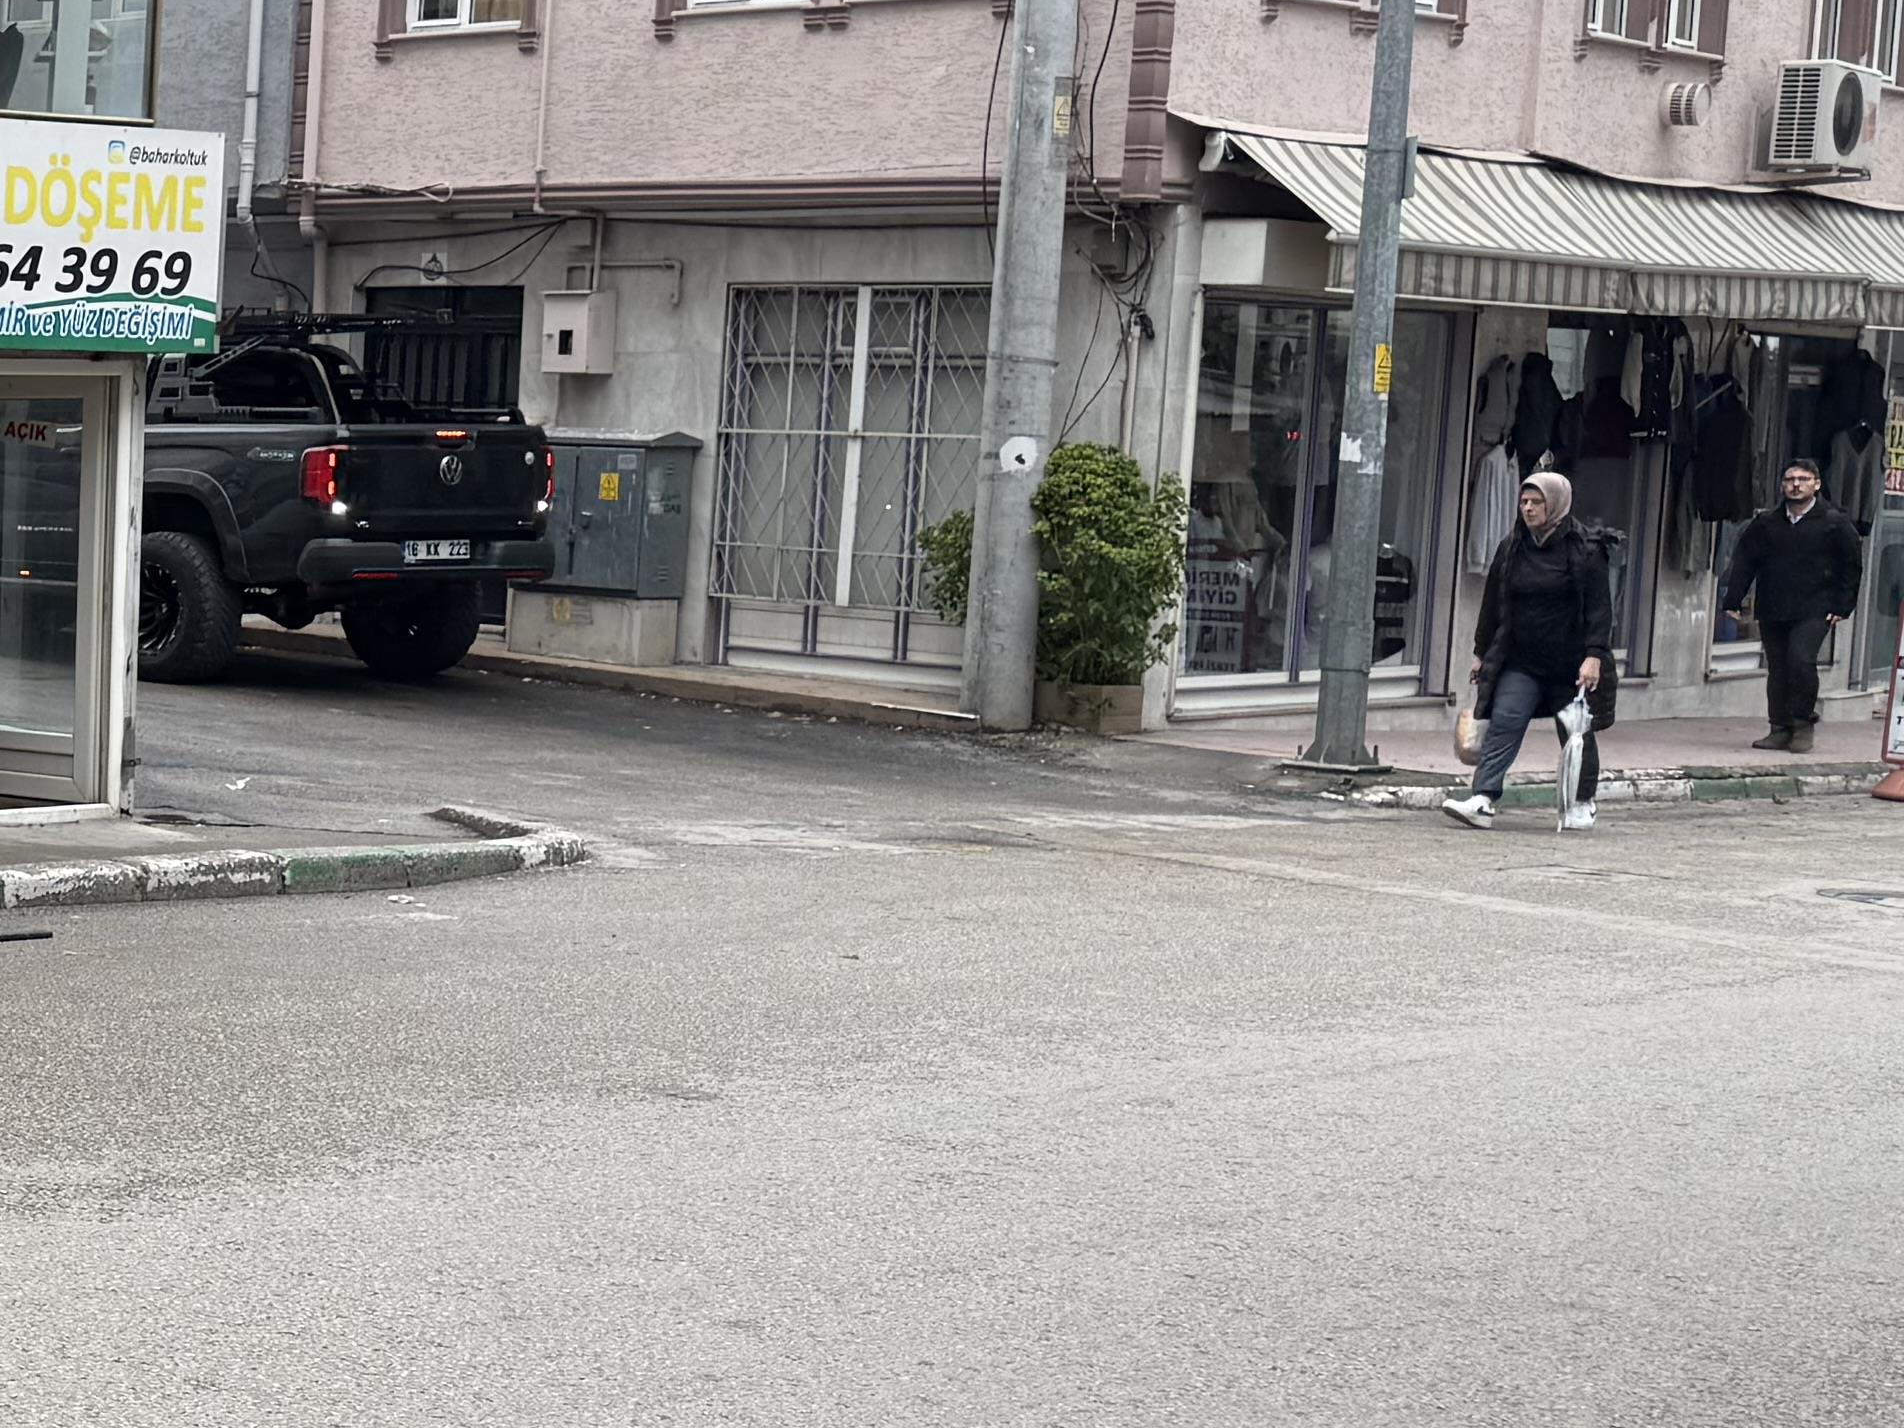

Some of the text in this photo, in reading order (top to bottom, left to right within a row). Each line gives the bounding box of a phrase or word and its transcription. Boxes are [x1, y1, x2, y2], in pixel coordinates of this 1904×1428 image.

[128, 143, 209, 167] @baharkoltuk
[3, 153, 208, 244] DÖŞEME
[54, 246, 119, 295] 39
[130, 250, 193, 297] 69
[30, 310, 54, 336] ve
[58, 301, 100, 339] YÜZ
[100, 304, 194, 345] DEĞİŞİMİ
[4, 421, 48, 442] AÇIK
